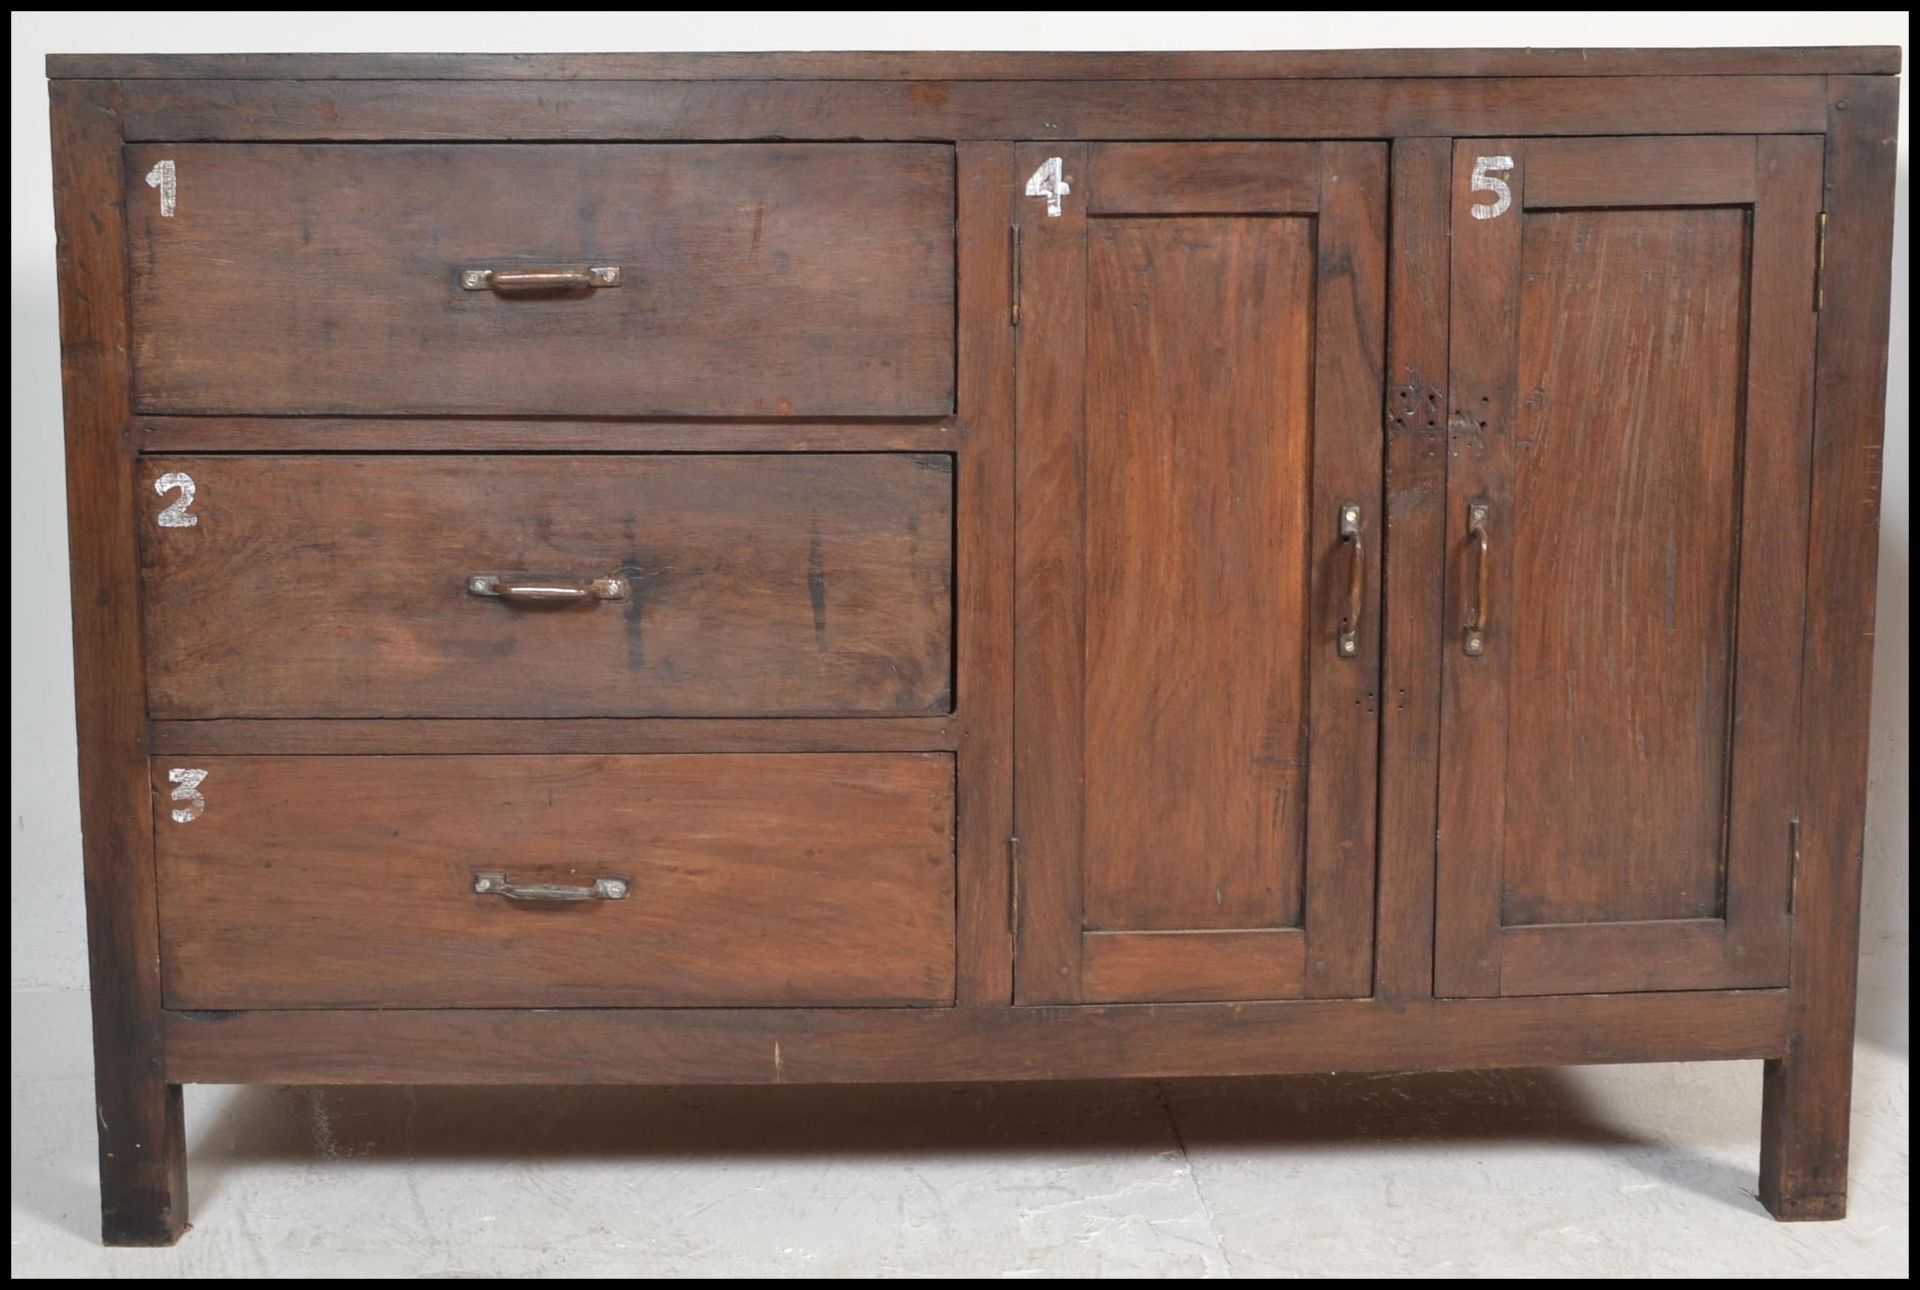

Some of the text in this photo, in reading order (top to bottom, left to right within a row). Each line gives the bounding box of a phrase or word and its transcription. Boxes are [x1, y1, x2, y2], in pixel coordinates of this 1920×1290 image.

[145, 160, 176, 217] 1
[1025, 157, 1070, 217] 4
[1471, 156, 1514, 220] 5
[154, 472, 197, 528] 2
[168, 768, 208, 823] 3
